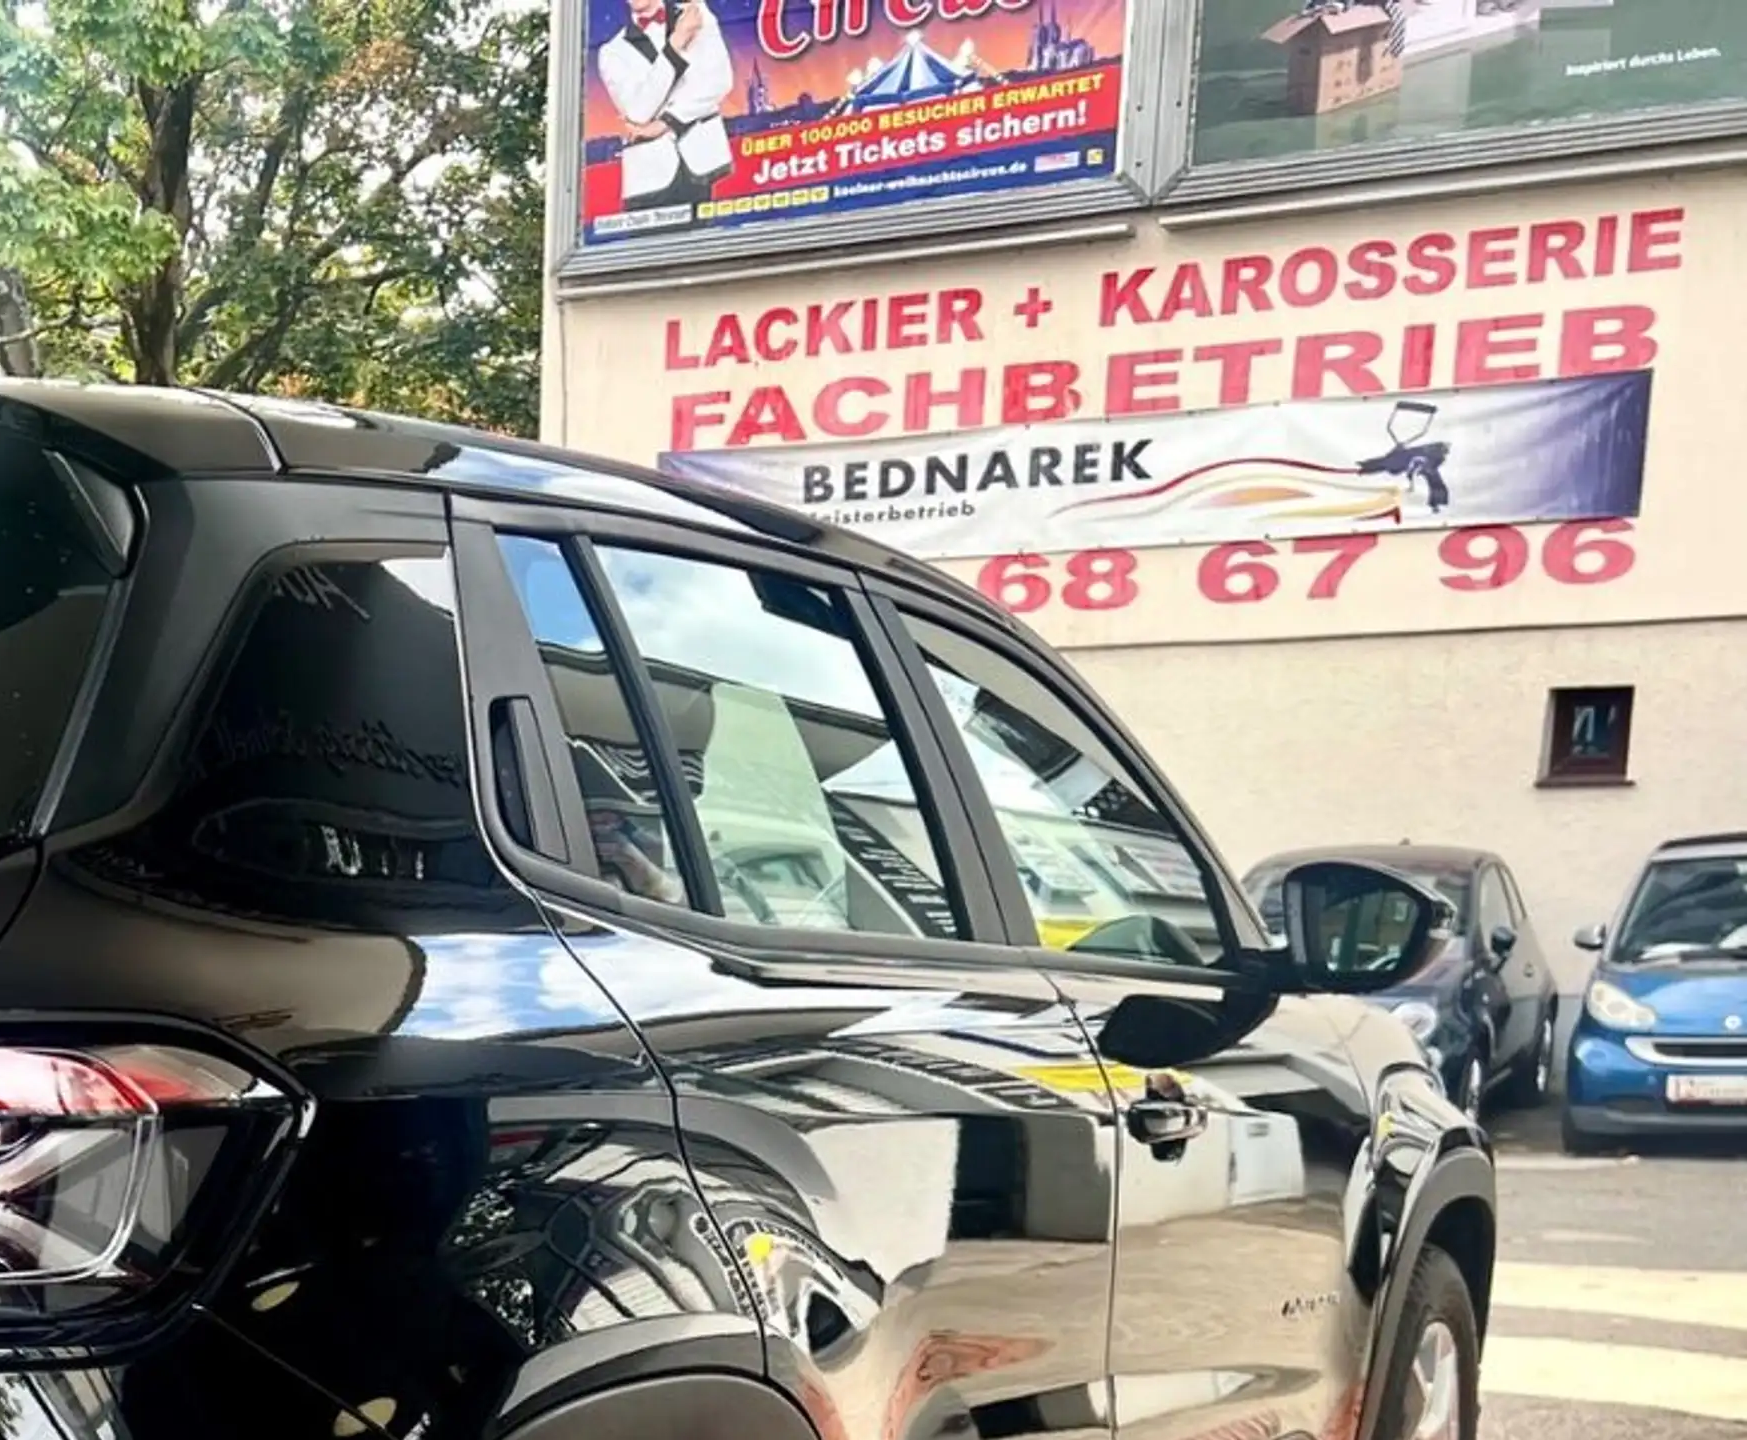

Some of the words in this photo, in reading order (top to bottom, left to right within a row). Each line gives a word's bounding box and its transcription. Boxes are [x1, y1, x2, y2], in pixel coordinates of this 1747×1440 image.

[757, 0, 1031, 58] Circ
[752, 148, 829, 185] Jetzt
[834, 130, 947, 169] Tickets
[955, 99, 1087, 148] sichern!
[800, 117, 873, 145] 100.000
[878, 95, 986, 130] BESUCHER
[992, 72, 1105, 109] ERWARTET
[664, 287, 985, 371] LACKIER
[1012, 286, 1053, 329] +
[1098, 207, 1685, 327] KAROSSERIE
[670, 303, 1659, 453] FACHBETRIEB
[802, 437, 1154, 505] BEDNAREK
[977, 546, 1139, 614] 68
[1196, 532, 1379, 604] 67
[1437, 516, 1637, 591] 96
